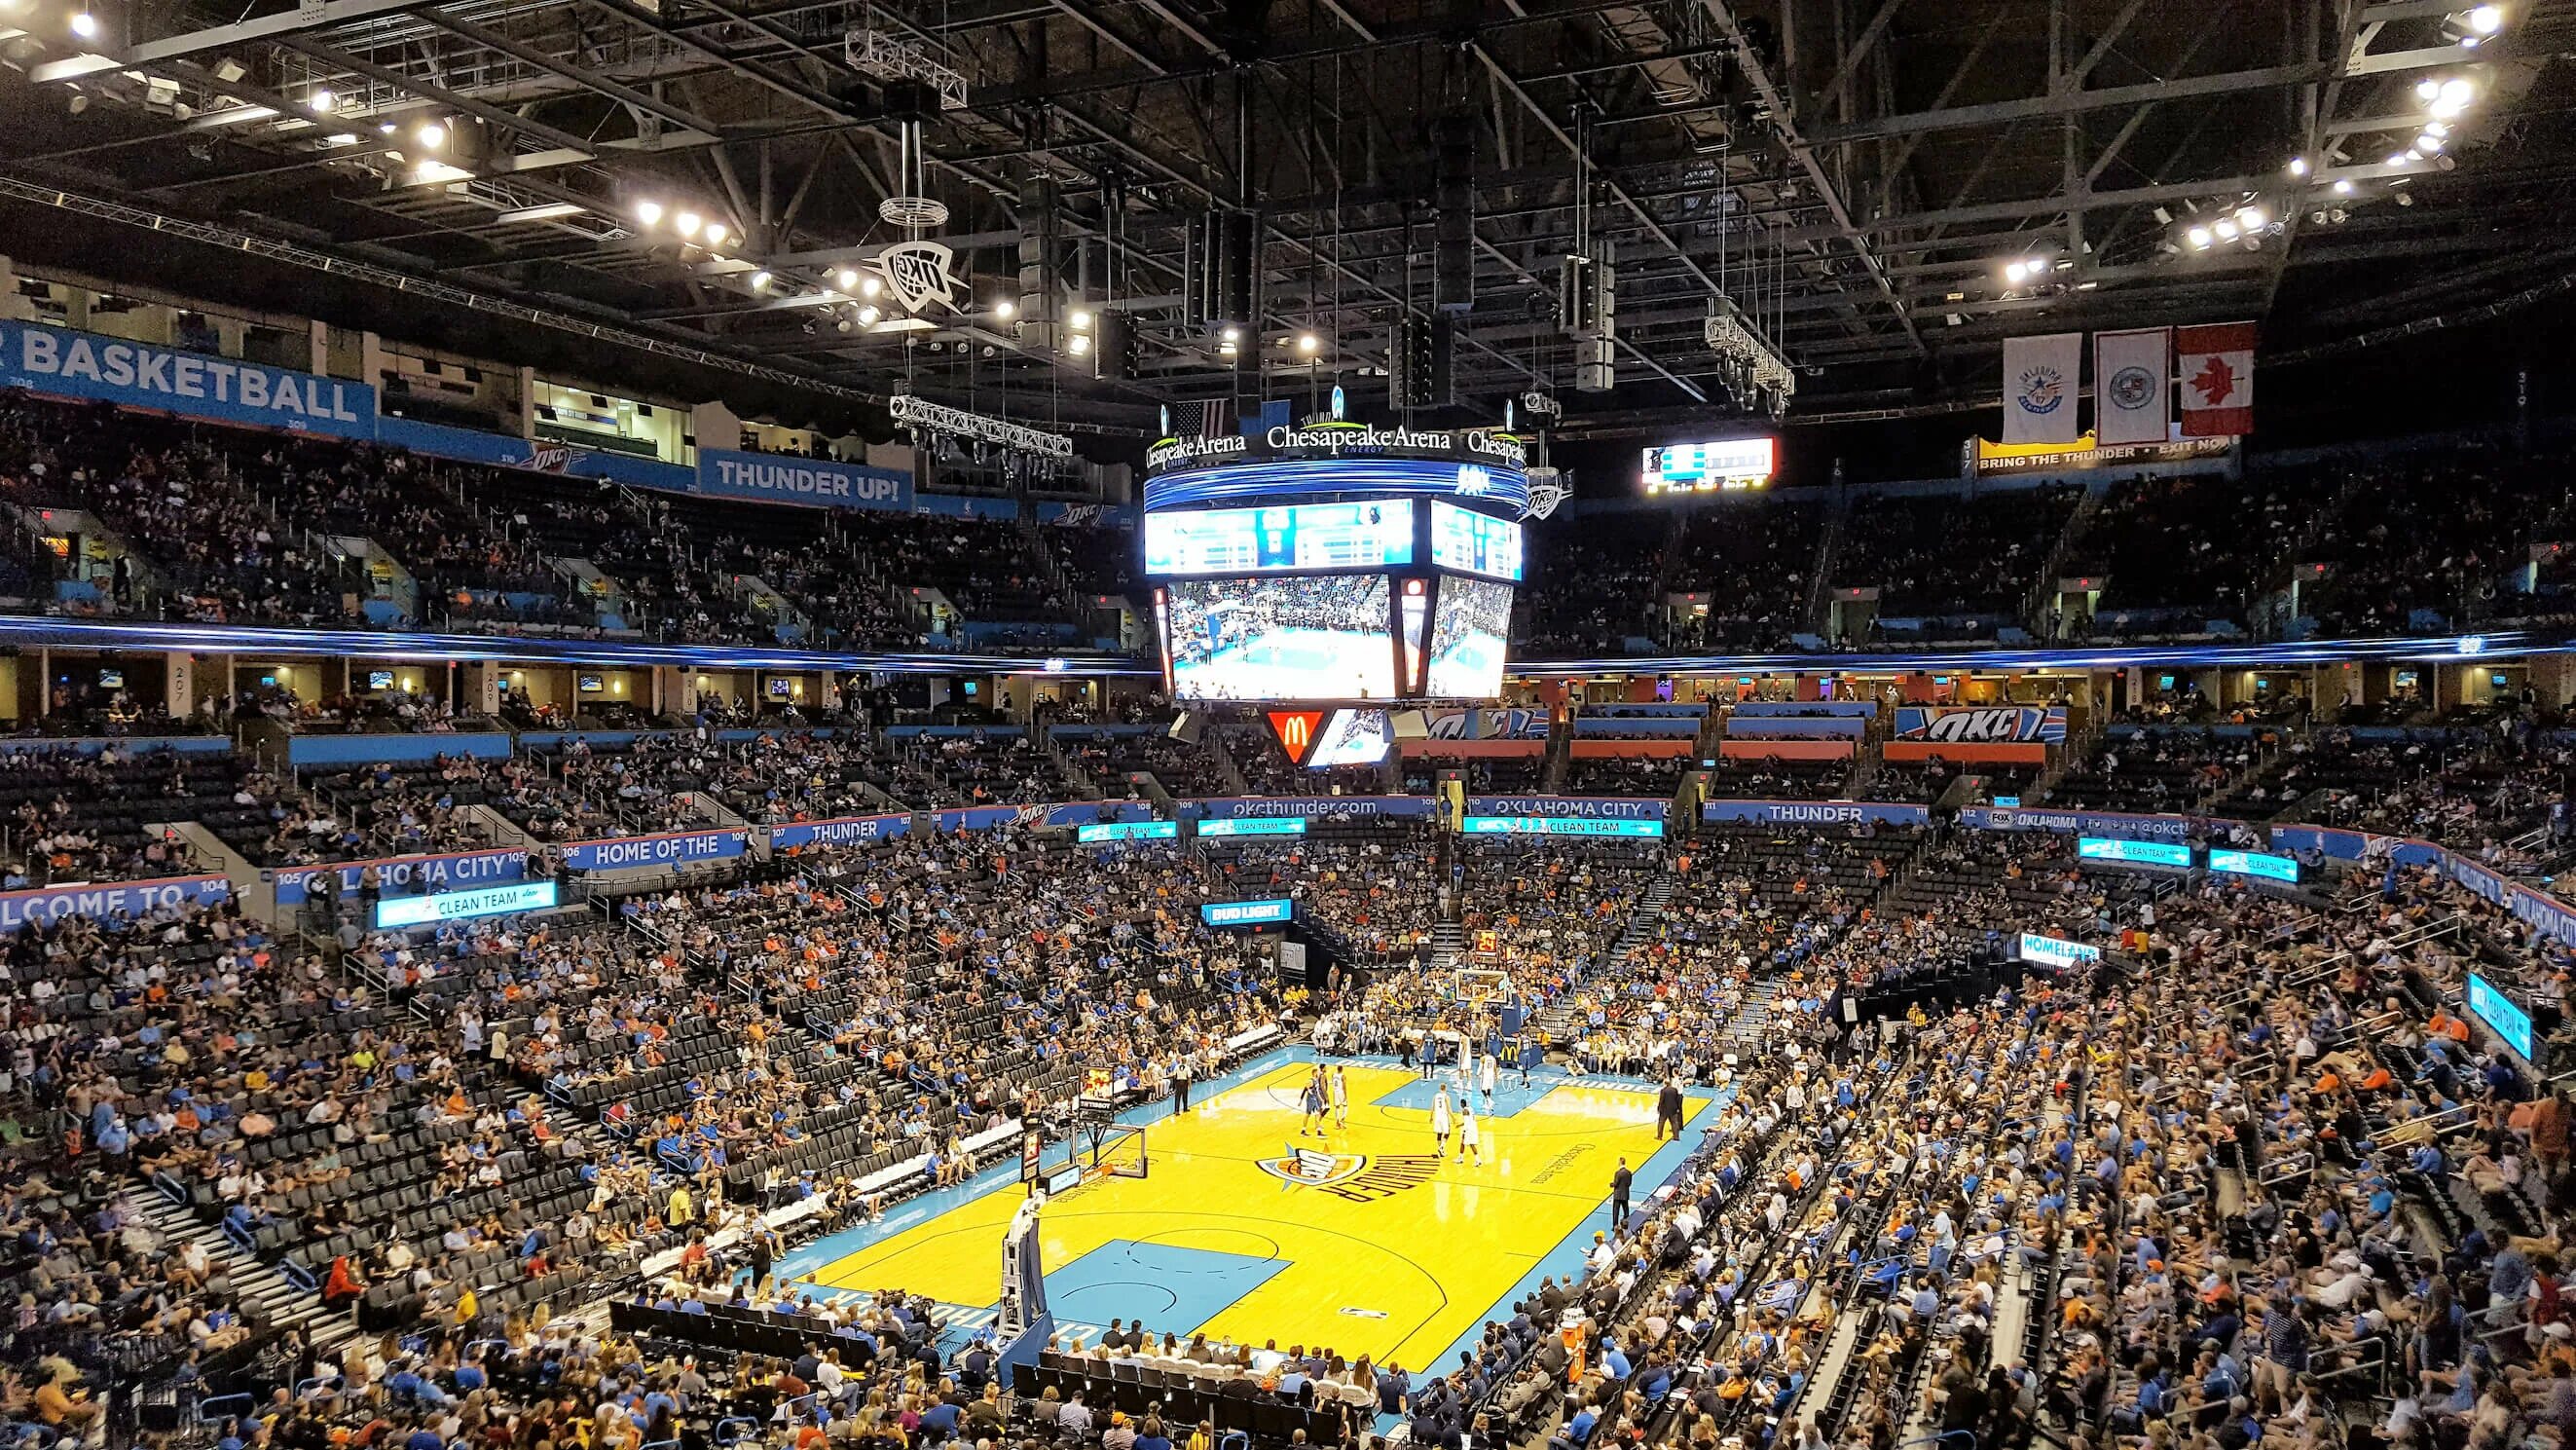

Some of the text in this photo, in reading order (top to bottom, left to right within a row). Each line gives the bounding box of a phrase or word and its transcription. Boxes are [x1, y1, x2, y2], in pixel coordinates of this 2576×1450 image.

[23, 329, 357, 423] BASKETBALL
[1268, 423, 1451, 455] Chesapeake Arena
[535, 448, 564, 470] OKC
[1146, 434, 1246, 470] Chesapeake Arena
[1980, 456, 2025, 469] BRING
[2032, 454, 2059, 465] THE
[2063, 447, 2135, 463] THUNDER
[717, 460, 899, 503] THUNDER UP!
[1071, 504, 1096, 525] OKC
[1929, 709, 2017, 741] OKC
[1233, 799, 1376, 816] okcthunder.com
[1495, 800, 1641, 816] OKLAHOMA CITY
[1769, 805, 1862, 822] THUNDER
[812, 820, 877, 841] THUNDER
[1550, 822, 1619, 832] CLEAN TEAM
[1992, 813, 2010, 823] FOX
[2018, 814, 2077, 829] OKLAHOMA
[731, 832, 746, 841] 106
[507, 851, 526, 863] 105
[562, 846, 579, 858] 106
[596, 836, 718, 865] HOME OF THE
[2123, 846, 2166, 857] CLEAN TEAM
[456, 854, 506, 879] CITY
[200, 879, 227, 893] 104
[278, 873, 301, 885] 105
[139, 884, 184, 911] TO
[438, 897, 480, 914] CLEAN
[483, 892, 517, 911] TEAM
[1212, 905, 1281, 921] BUD LIGHT
